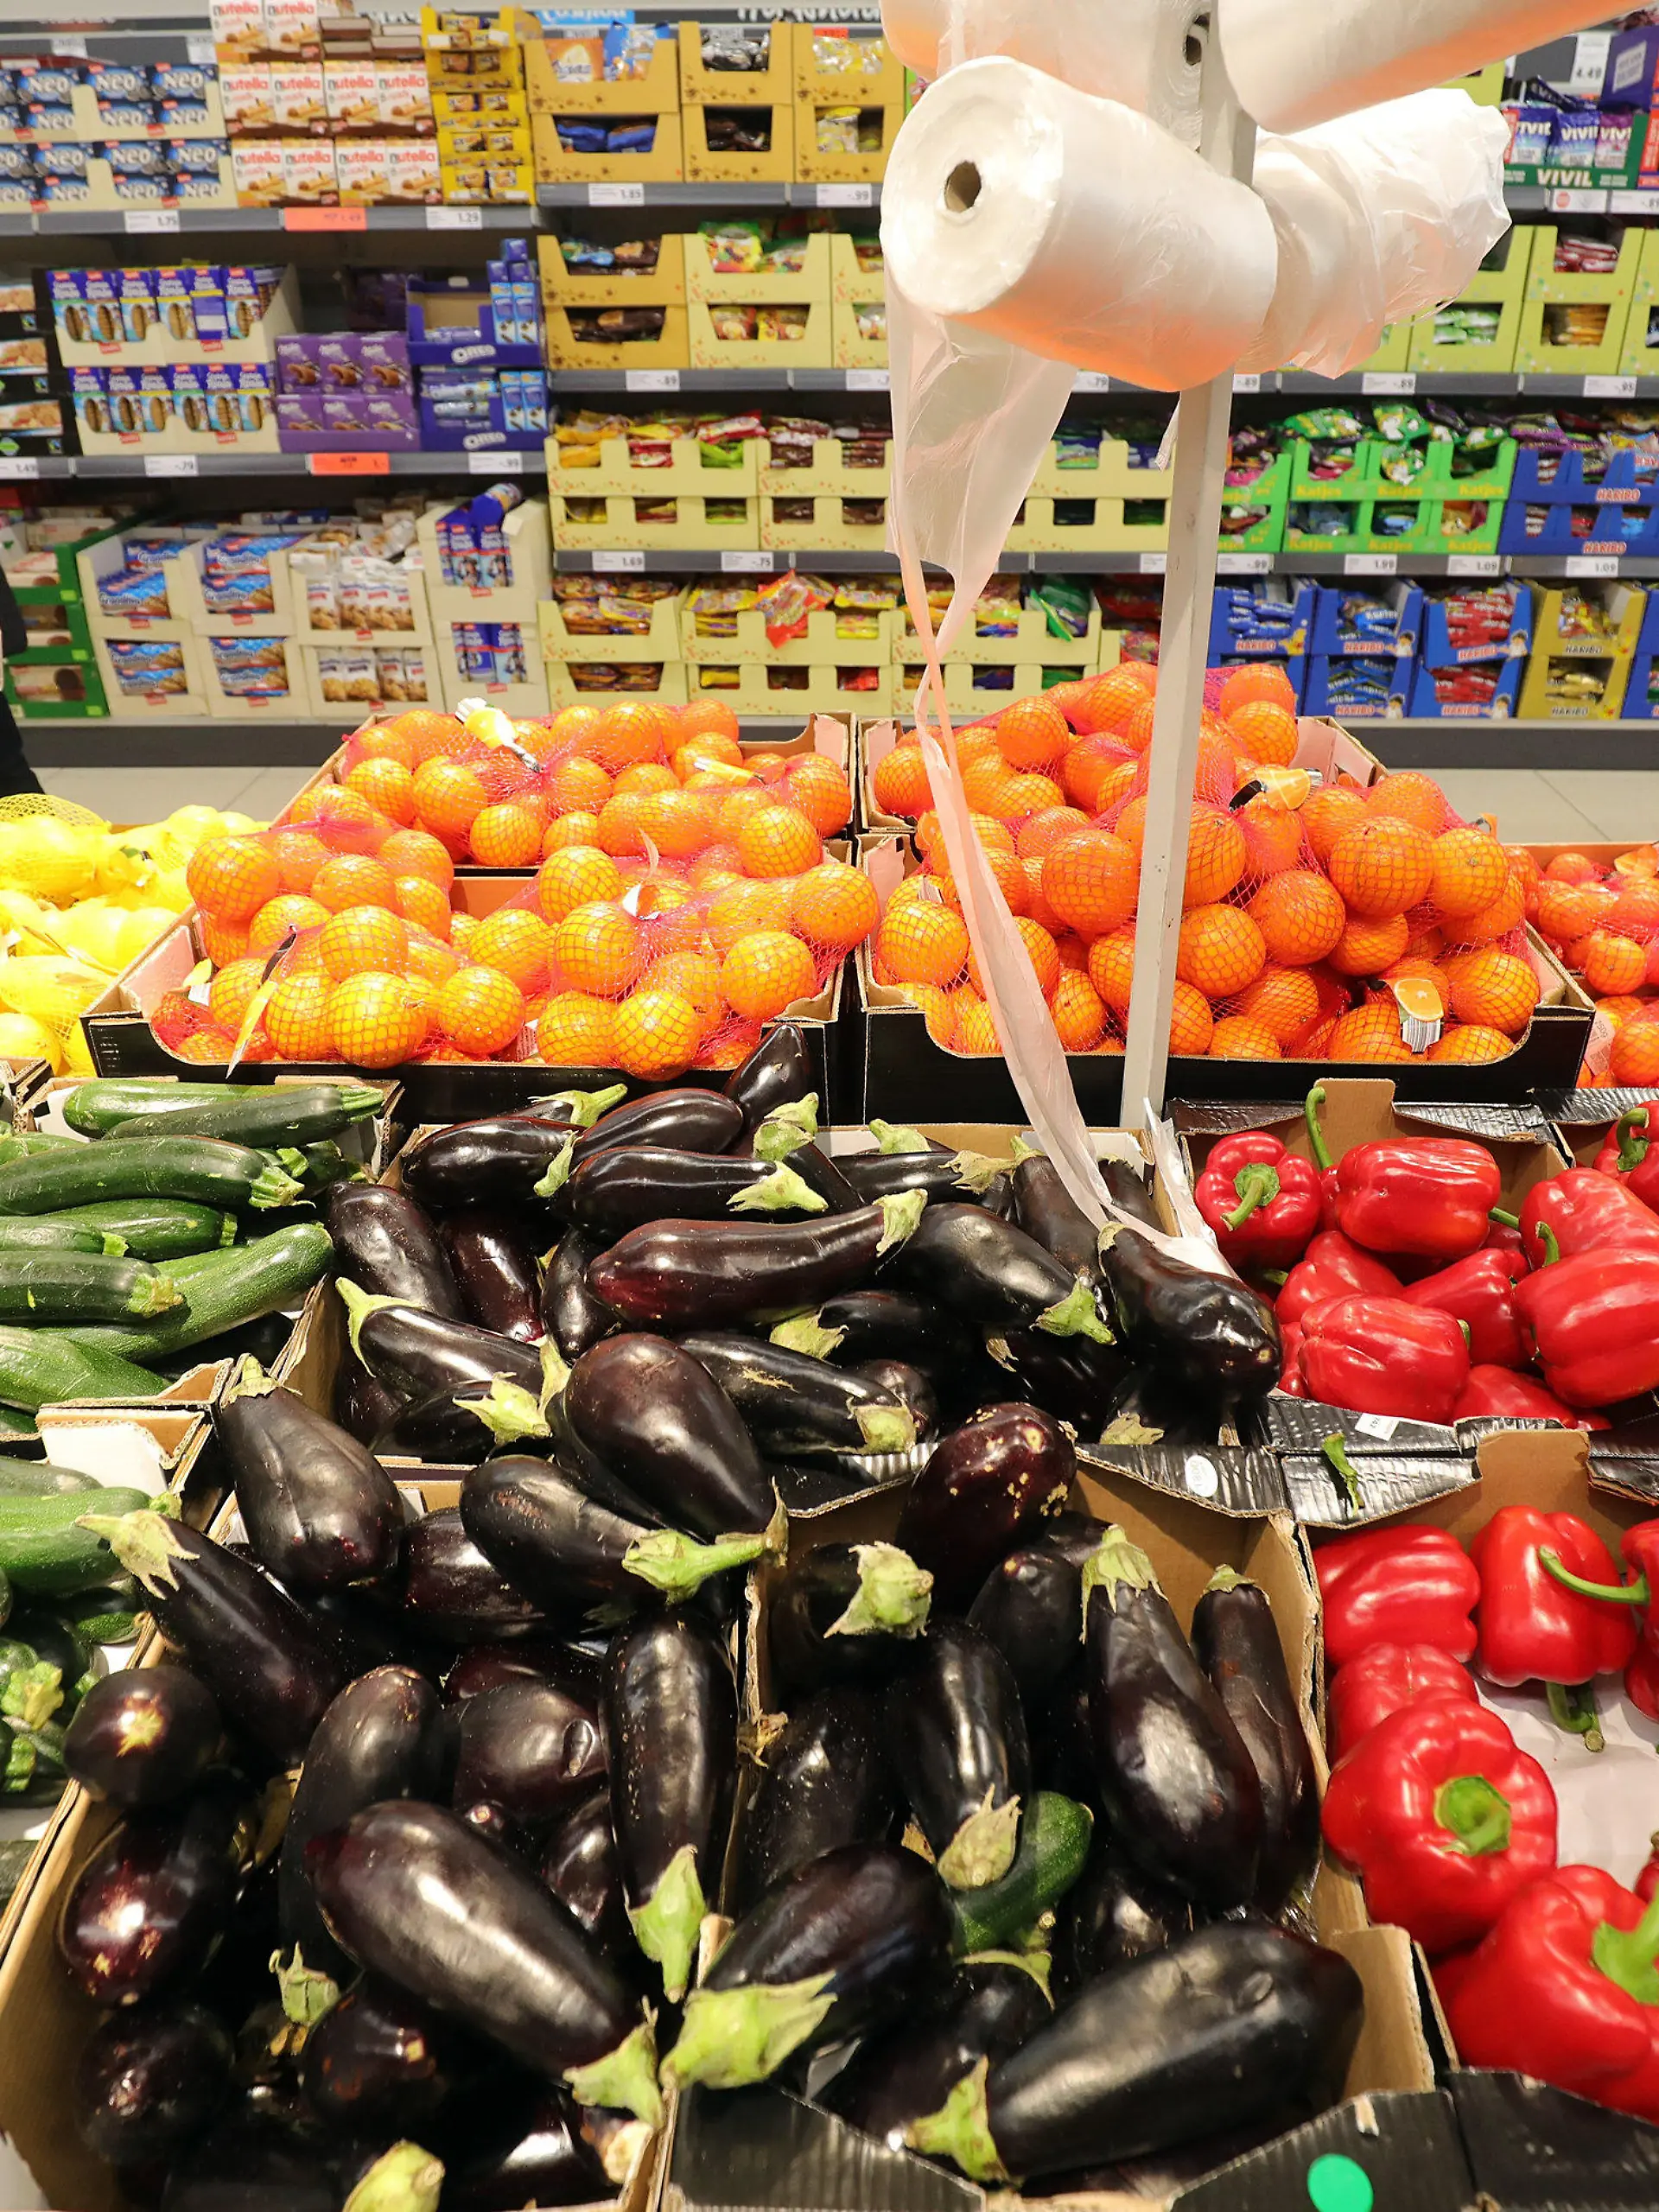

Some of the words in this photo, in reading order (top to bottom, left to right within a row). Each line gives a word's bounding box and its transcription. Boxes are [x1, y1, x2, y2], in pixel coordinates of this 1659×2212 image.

[223, 77, 269, 91] nutella
[274, 77, 321, 90] nutella
[327, 75, 373, 90] nutella
[378, 75, 424, 89] nutella
[235, 150, 281, 165] nutella
[285, 150, 331, 165] nutella
[338, 149, 384, 164] nutella
[389, 149, 435, 164] nutella
[1537, 168, 1592, 188] VIVIL
[1596, 488, 1641, 501] HARIBO
